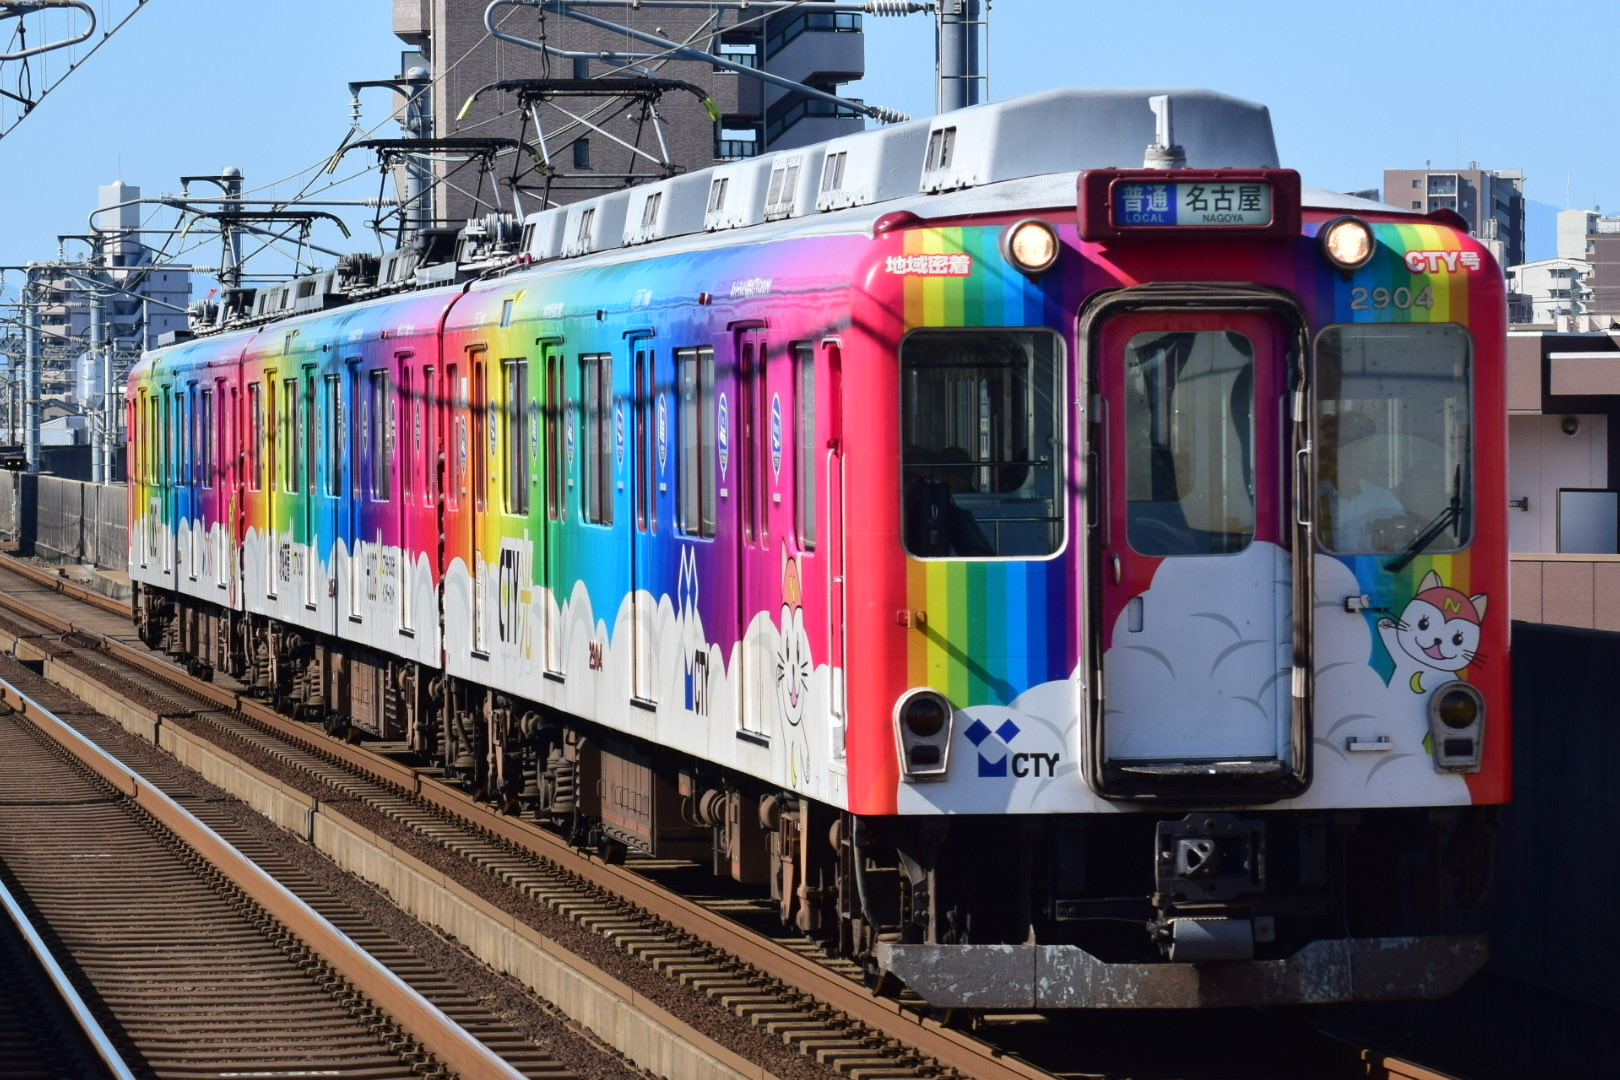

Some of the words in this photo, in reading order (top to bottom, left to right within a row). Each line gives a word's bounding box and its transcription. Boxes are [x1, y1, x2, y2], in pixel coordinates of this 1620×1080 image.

[1122, 184, 1168, 212] 普通
[1185, 185, 1262, 212] 名古屋
[1125, 213, 1165, 223] LOCAL
[1202, 213, 1244, 223] NAGOYA
[885, 255, 970, 275] 地域密着
[1405, 251, 1481, 272] CTY号
[1350, 286, 1434, 310] 2904
[694, 649, 709, 717] CTY
[1011, 752, 1060, 778] CTY
